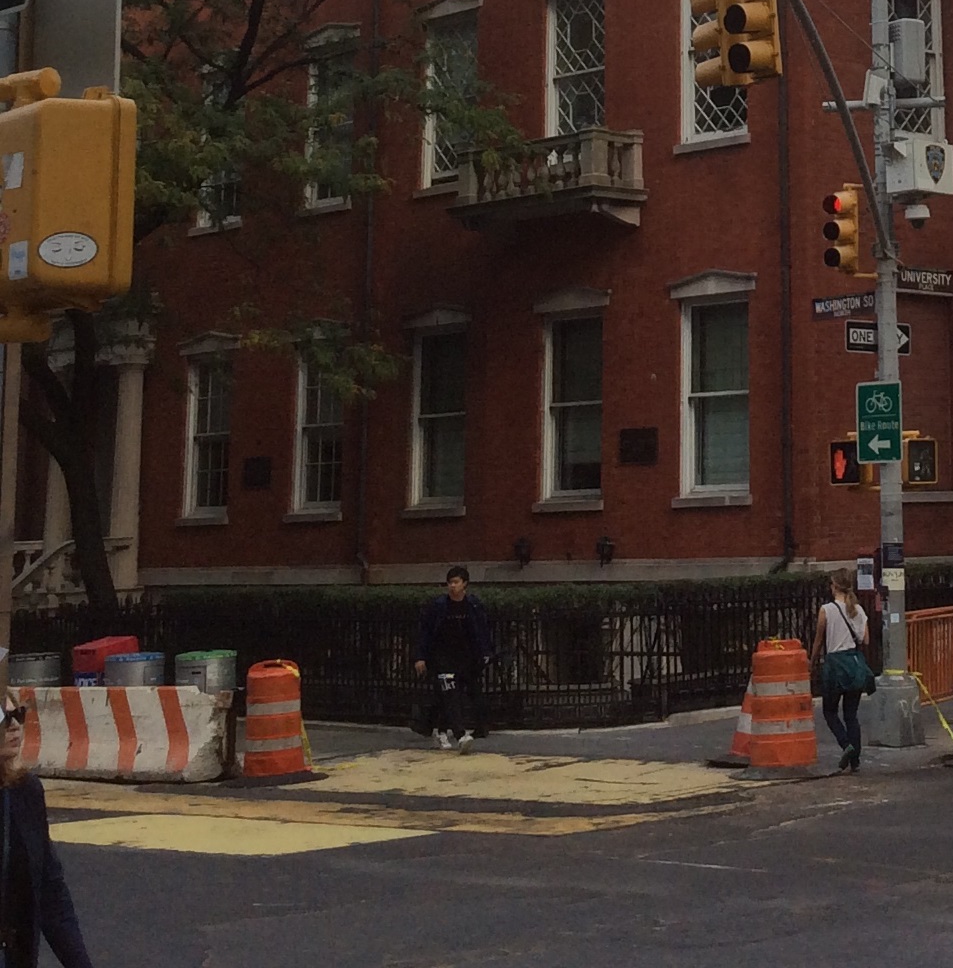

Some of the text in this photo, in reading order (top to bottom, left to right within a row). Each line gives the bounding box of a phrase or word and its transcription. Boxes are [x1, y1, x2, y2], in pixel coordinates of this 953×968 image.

[901, 270, 953, 286] UNIVERSITY
[815, 297, 861, 314] WASHINGTON
[851, 330, 873, 342] ONE
[860, 420, 899, 431] Bike Route
